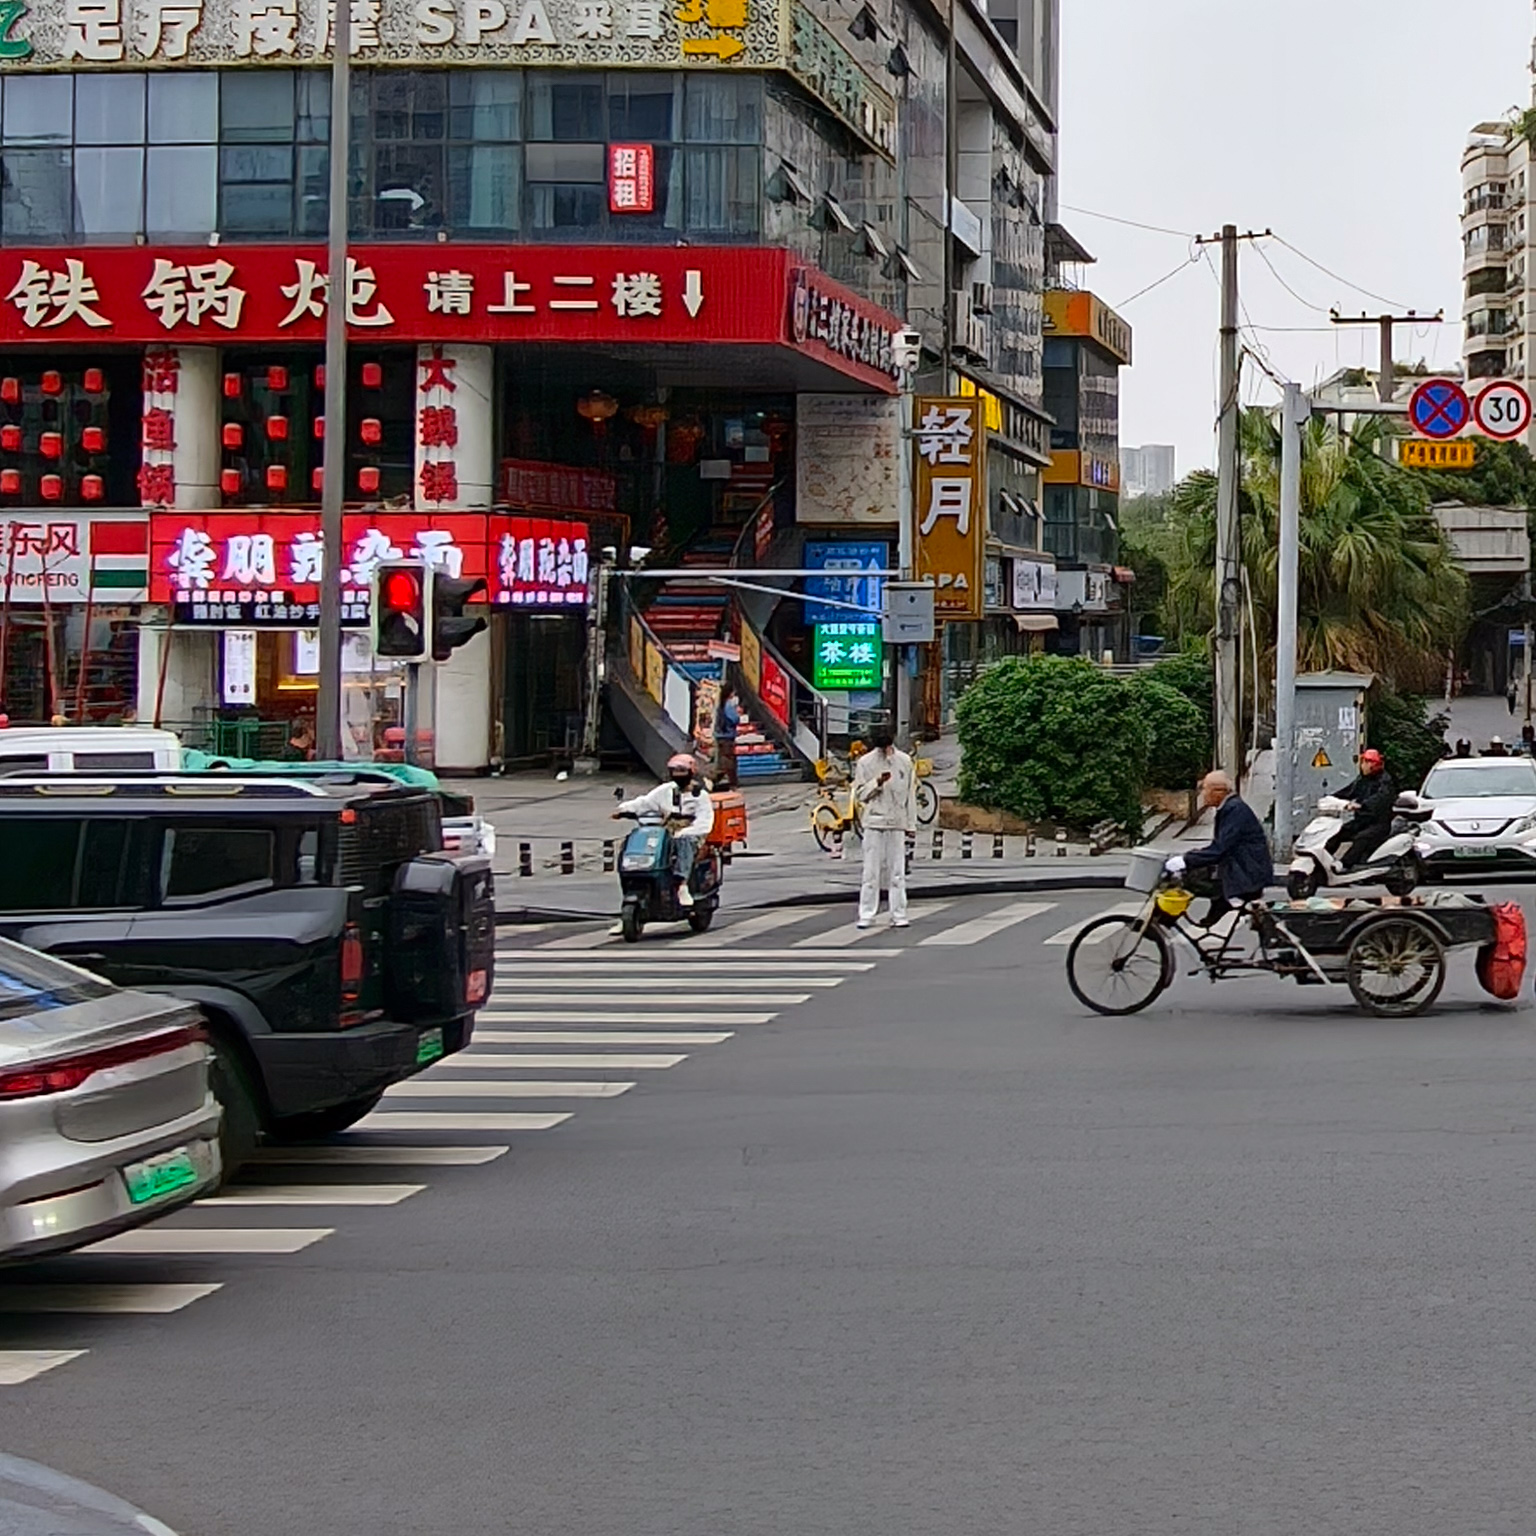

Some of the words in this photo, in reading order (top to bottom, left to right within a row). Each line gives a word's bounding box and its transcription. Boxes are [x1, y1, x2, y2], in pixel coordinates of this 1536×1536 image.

[414, 0, 556, 45] SPA
[574, 2, 666, 42] 采耳
[614, 148, 637, 207] 招租
[6, 258, 394, 328] 铁锅炖
[423, 272, 663, 317] 请上二楼
[1489, 397, 1520, 422] 30
[920, 405, 973, 535] 轻月
[819, 640, 877, 664] 茶楼
